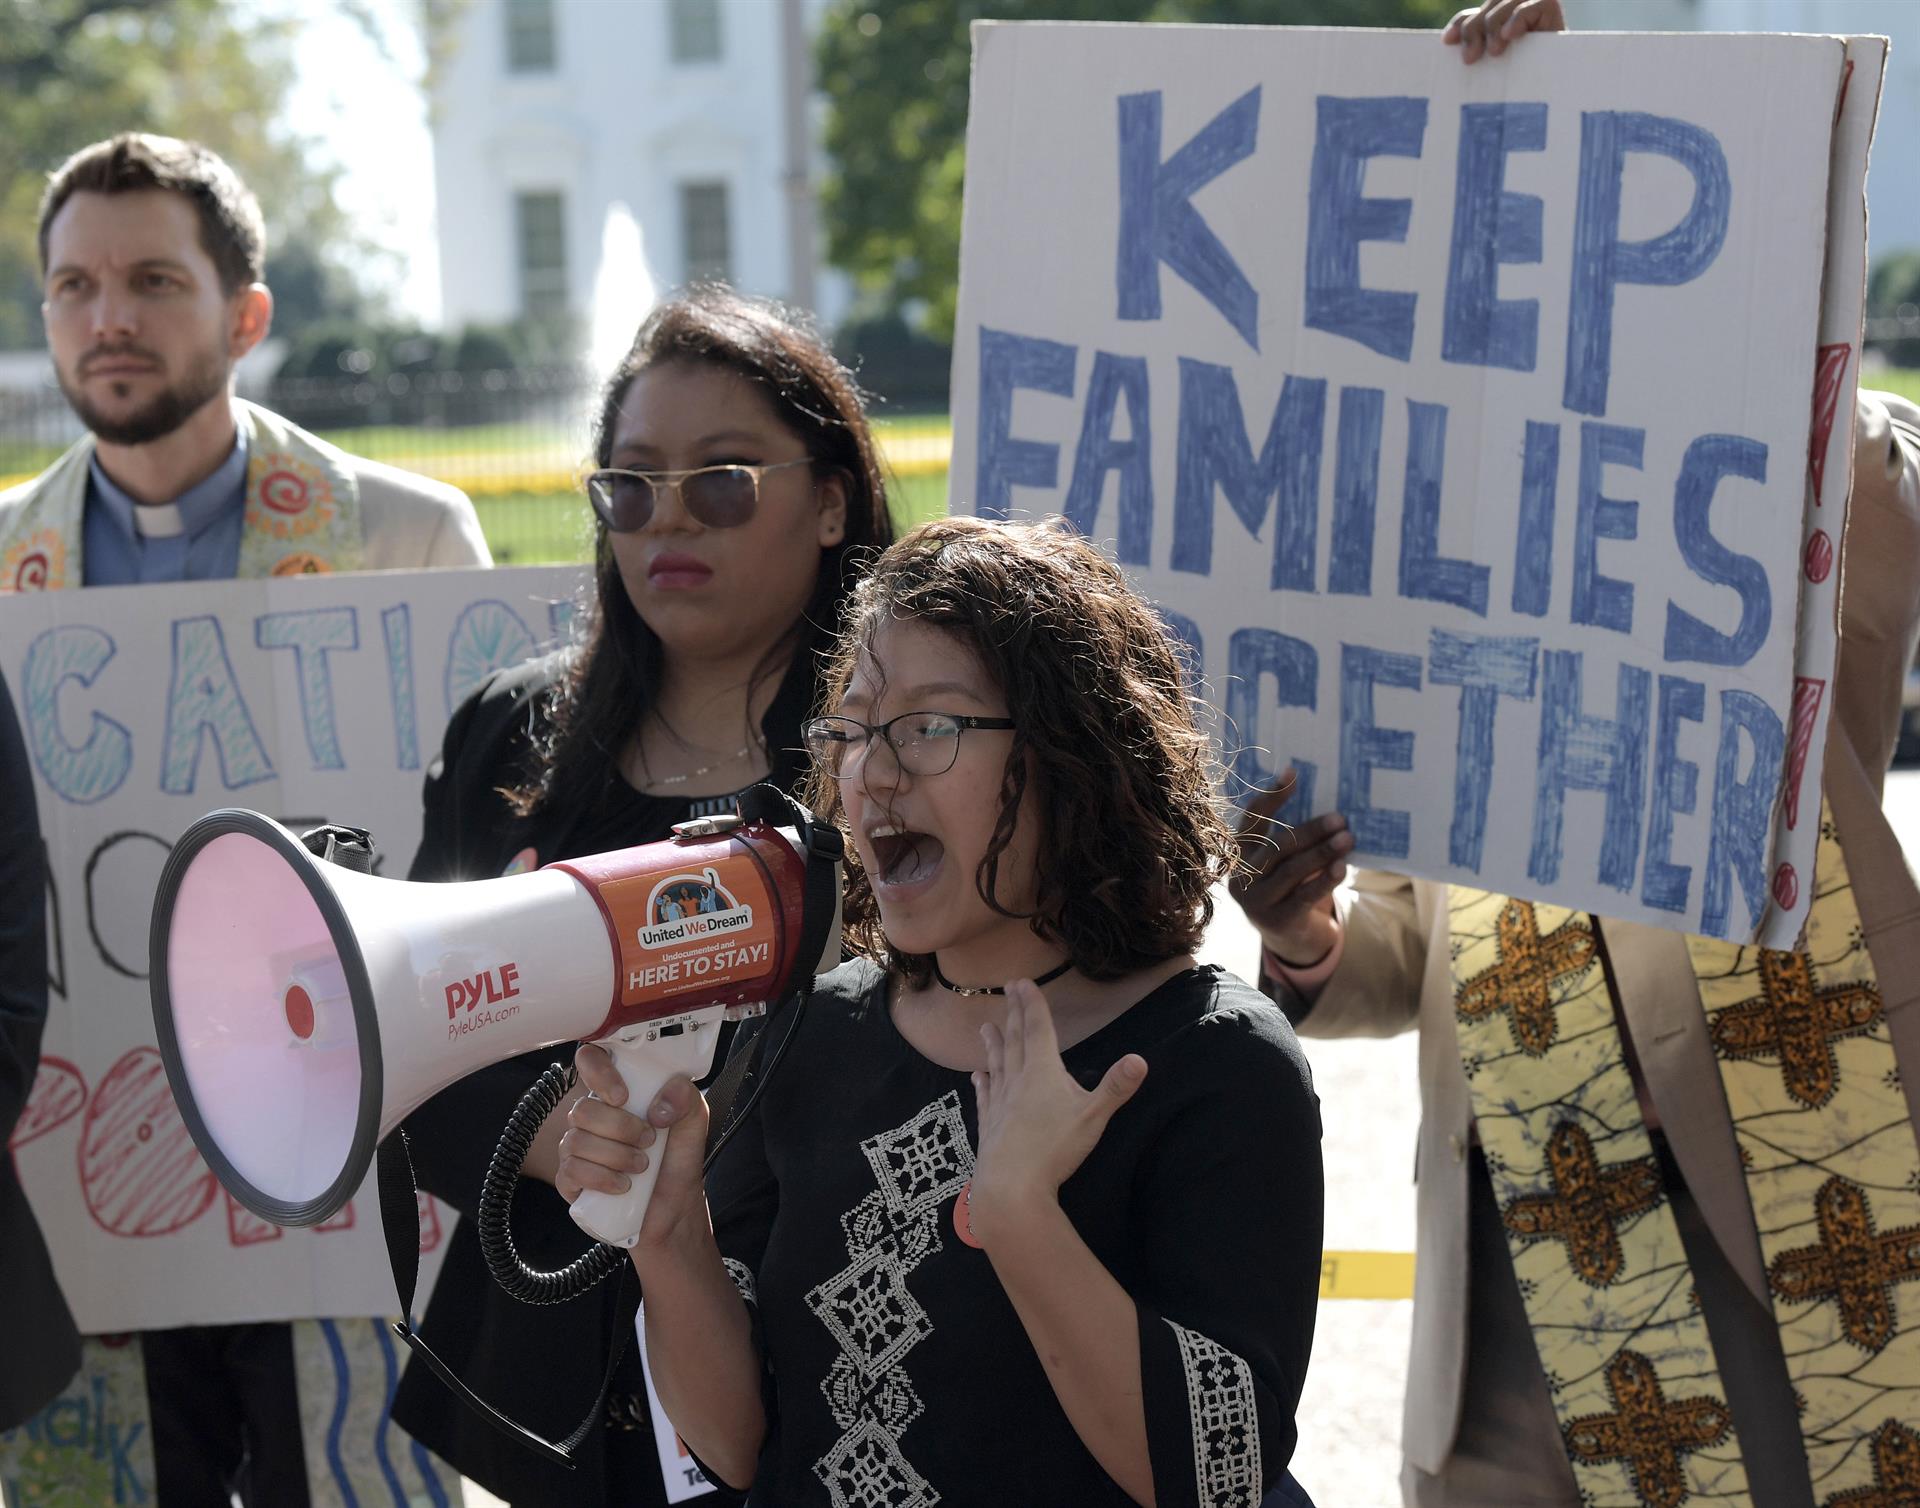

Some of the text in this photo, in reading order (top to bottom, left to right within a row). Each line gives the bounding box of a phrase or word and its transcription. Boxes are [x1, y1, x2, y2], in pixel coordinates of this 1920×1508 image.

[1117, 83, 1731, 417] KEEP
[976, 324, 1774, 666] FAMILIES
[1158, 605, 1786, 938] GETHER
[642, 913, 748, 945] United We Dream
[662, 939, 736, 962] Undocumented and
[445, 962, 520, 1020] PYLE
[629, 943, 769, 990] HERE TO STAY!
[448, 1005, 520, 1043] PyleUSA.com
